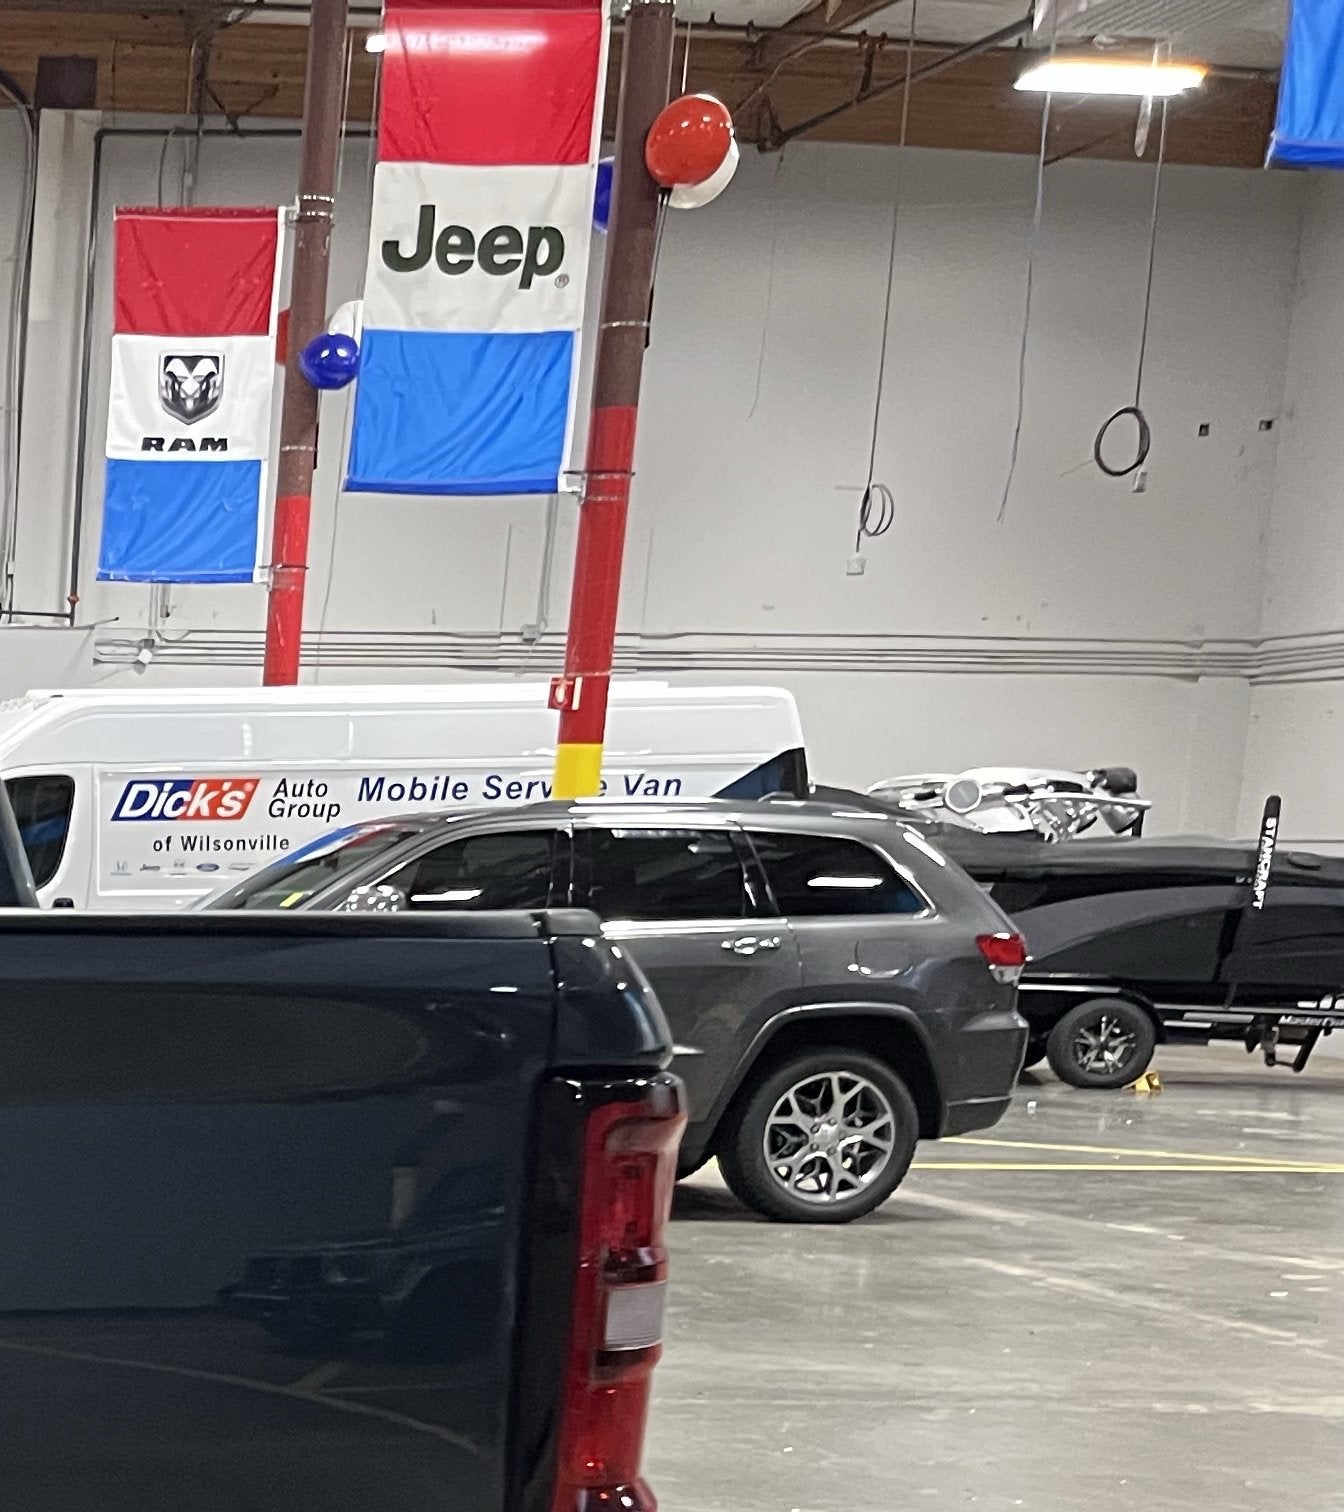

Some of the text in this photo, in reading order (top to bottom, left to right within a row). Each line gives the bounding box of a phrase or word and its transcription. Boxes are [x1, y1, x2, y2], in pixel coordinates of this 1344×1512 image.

[381, 204, 565, 290] Jeep
[141, 437, 229, 452] RAM
[272, 778, 329, 798] Auto
[357, 773, 682, 801] Mobile Serve Van
[118, 782, 248, 818] Dick's
[267, 799, 342, 823] Group
[153, 834, 290, 852] of Wilsonville
